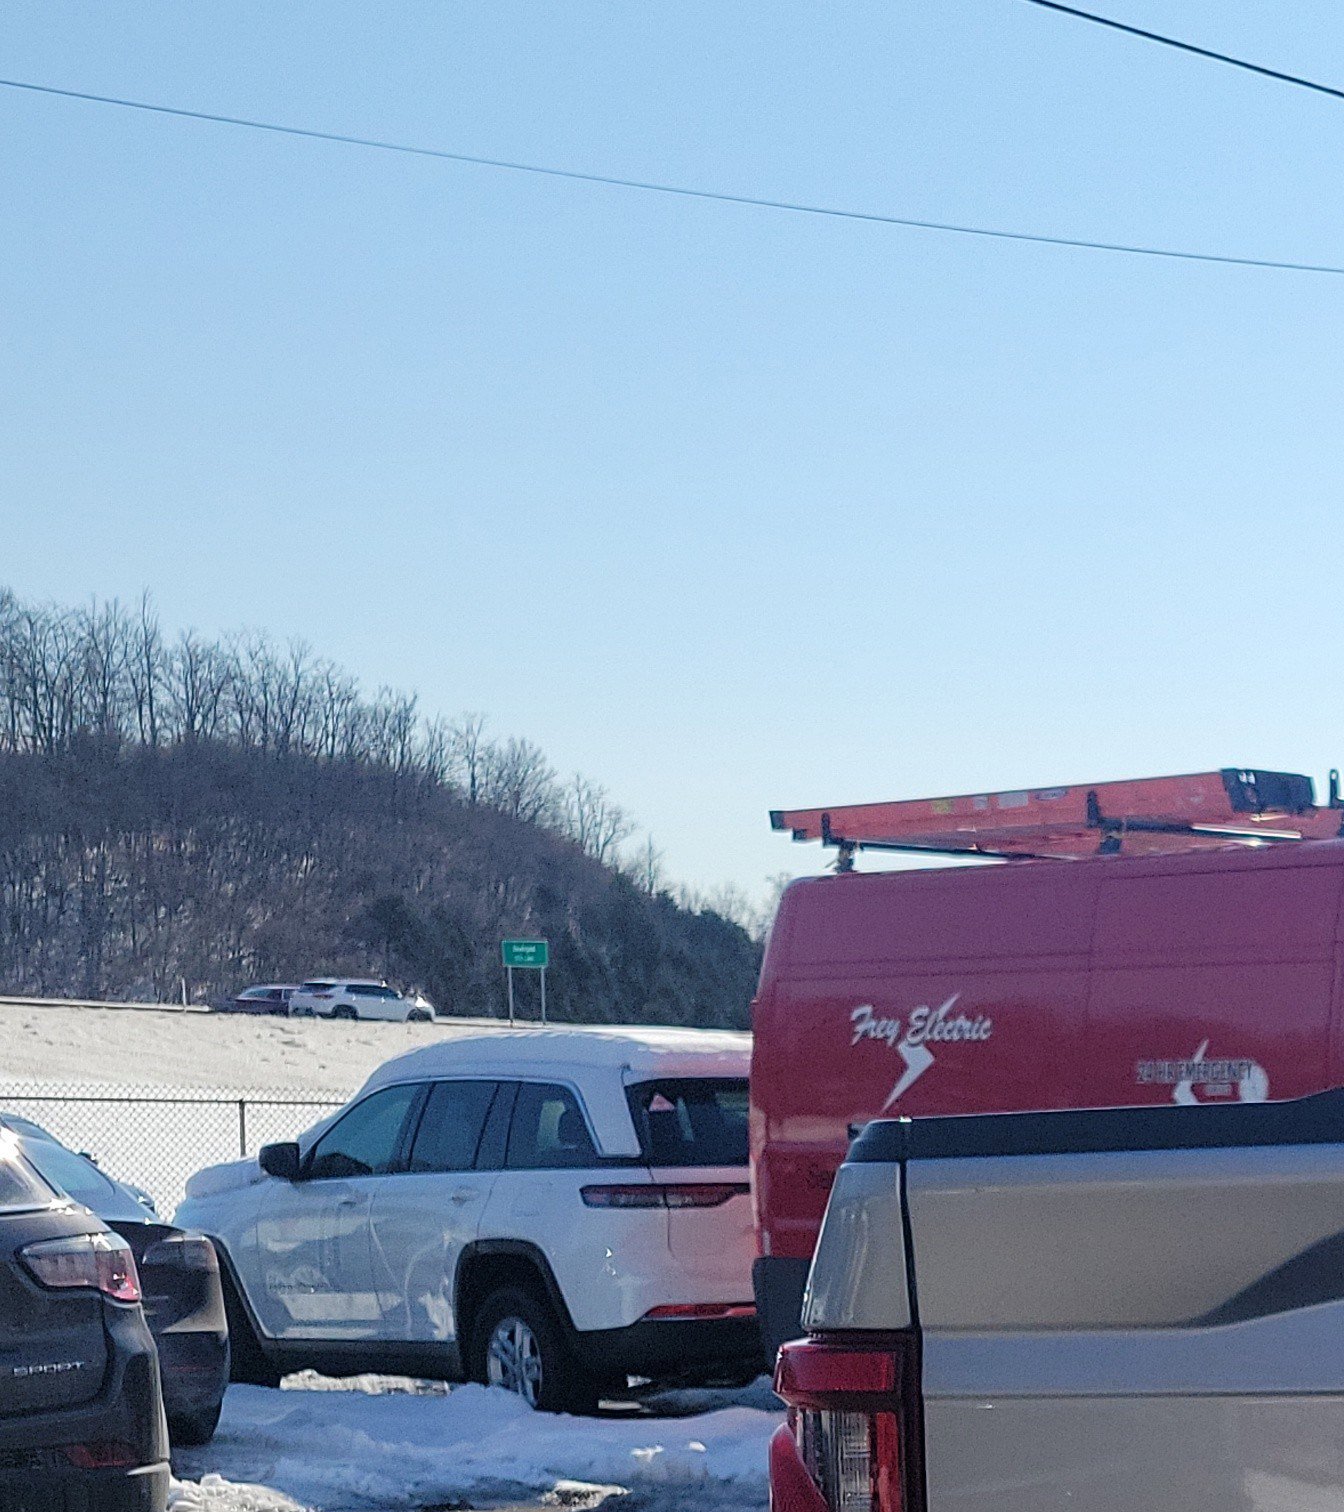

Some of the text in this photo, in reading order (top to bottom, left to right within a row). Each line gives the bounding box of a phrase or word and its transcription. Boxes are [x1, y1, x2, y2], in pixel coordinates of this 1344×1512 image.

[850, 1003, 993, 1047] Frey Electric
[13, 1361, 84, 1377] SPORT
